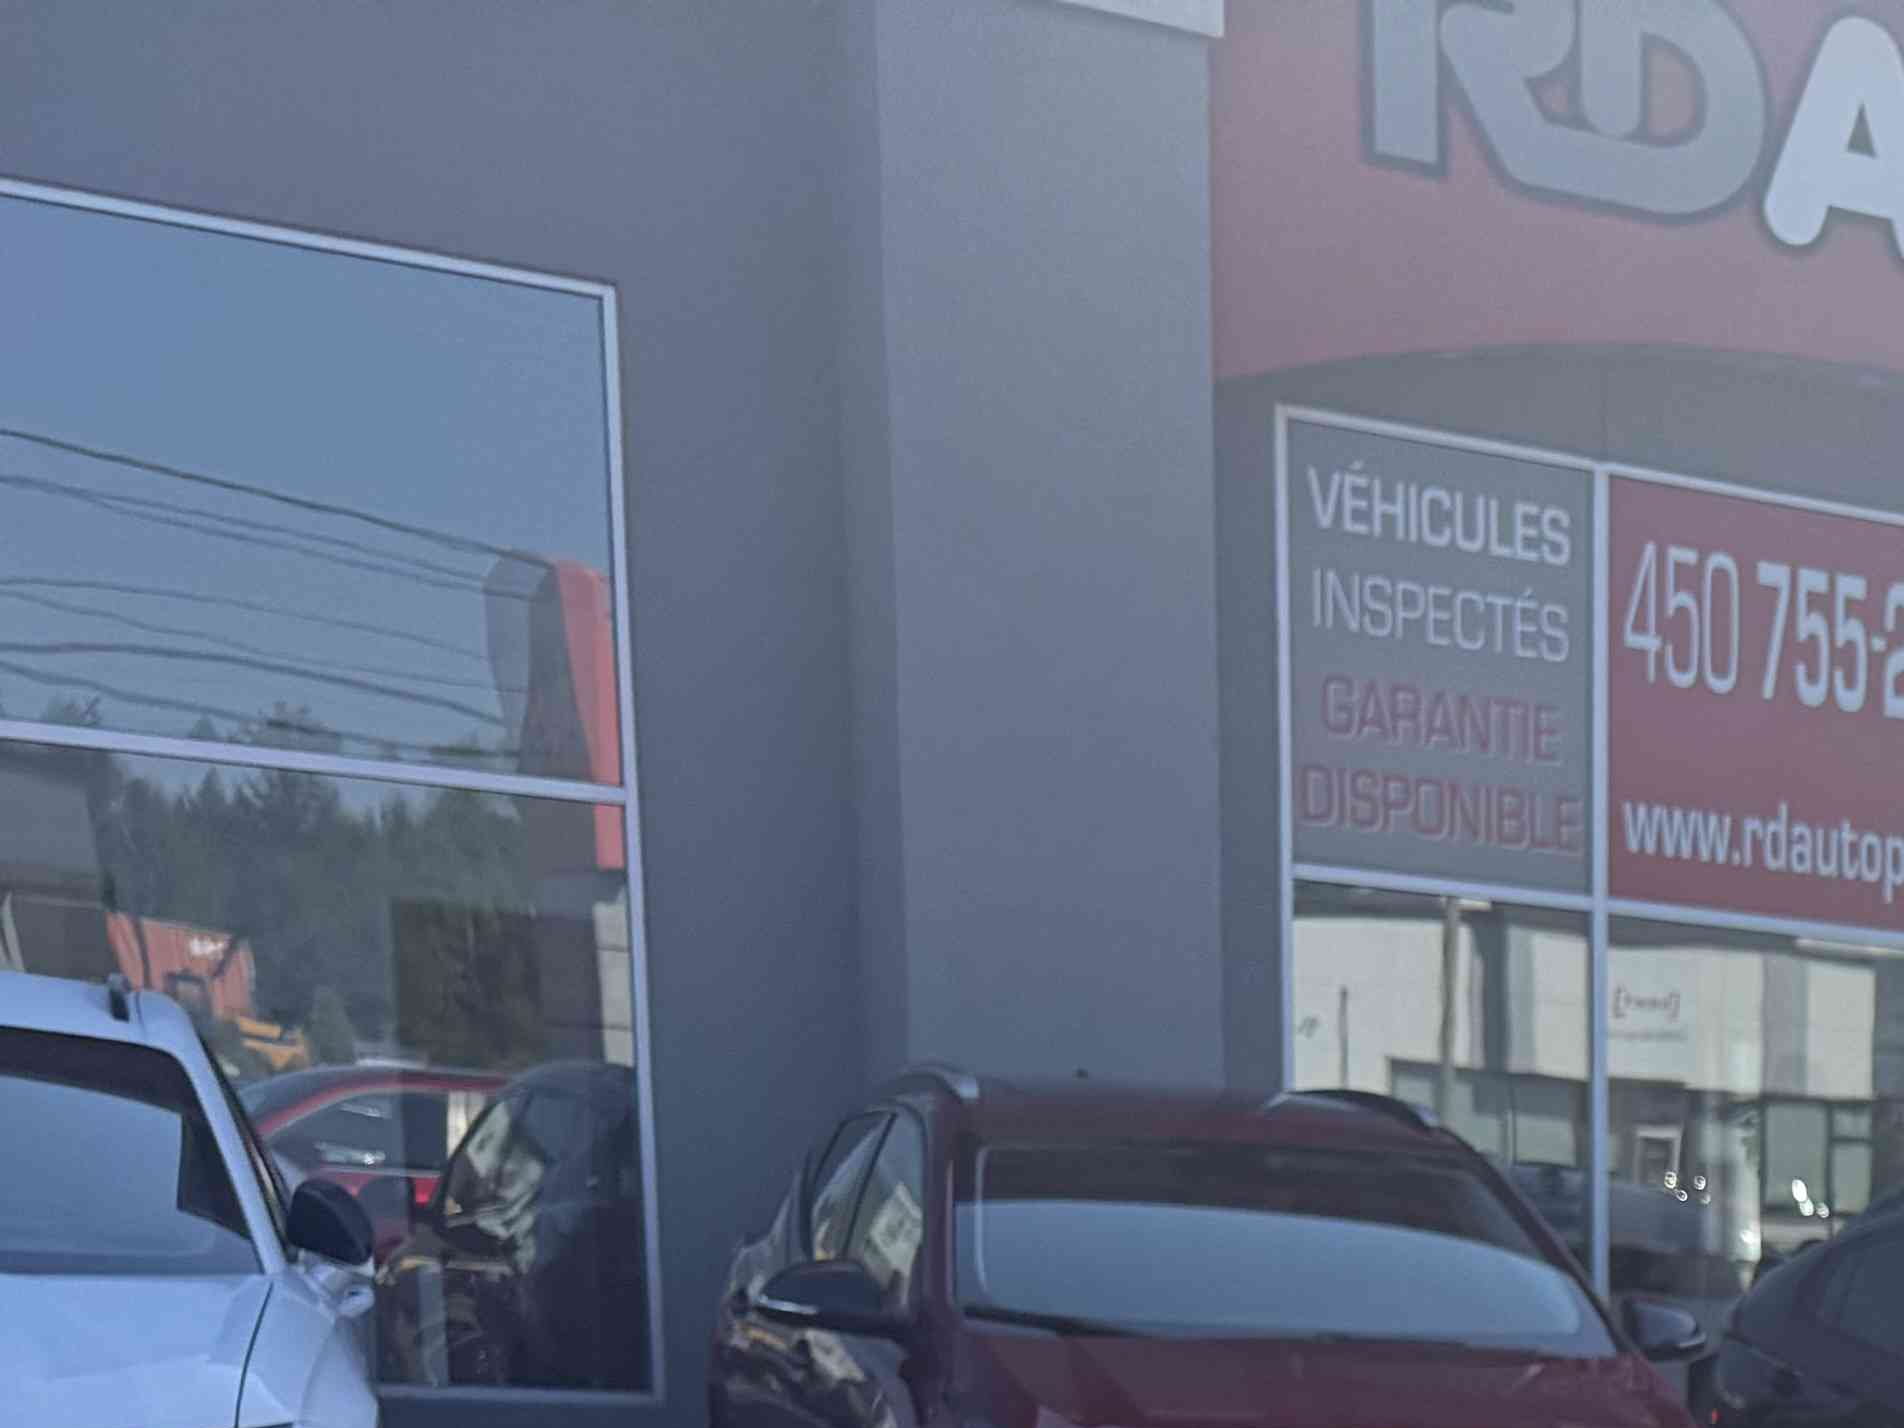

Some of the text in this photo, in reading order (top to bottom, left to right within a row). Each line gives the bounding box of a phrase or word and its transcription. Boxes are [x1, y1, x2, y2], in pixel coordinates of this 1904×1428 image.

[1366, 0, 1768, 216] RD
[1306, 459, 1571, 566] VÉHICULES
[1311, 566, 1570, 663] INSPECTÉS
[1623, 540, 1740, 696] 450
[1322, 673, 1564, 768] GARANTIE
[1301, 764, 1585, 857] DISPONIBLE
